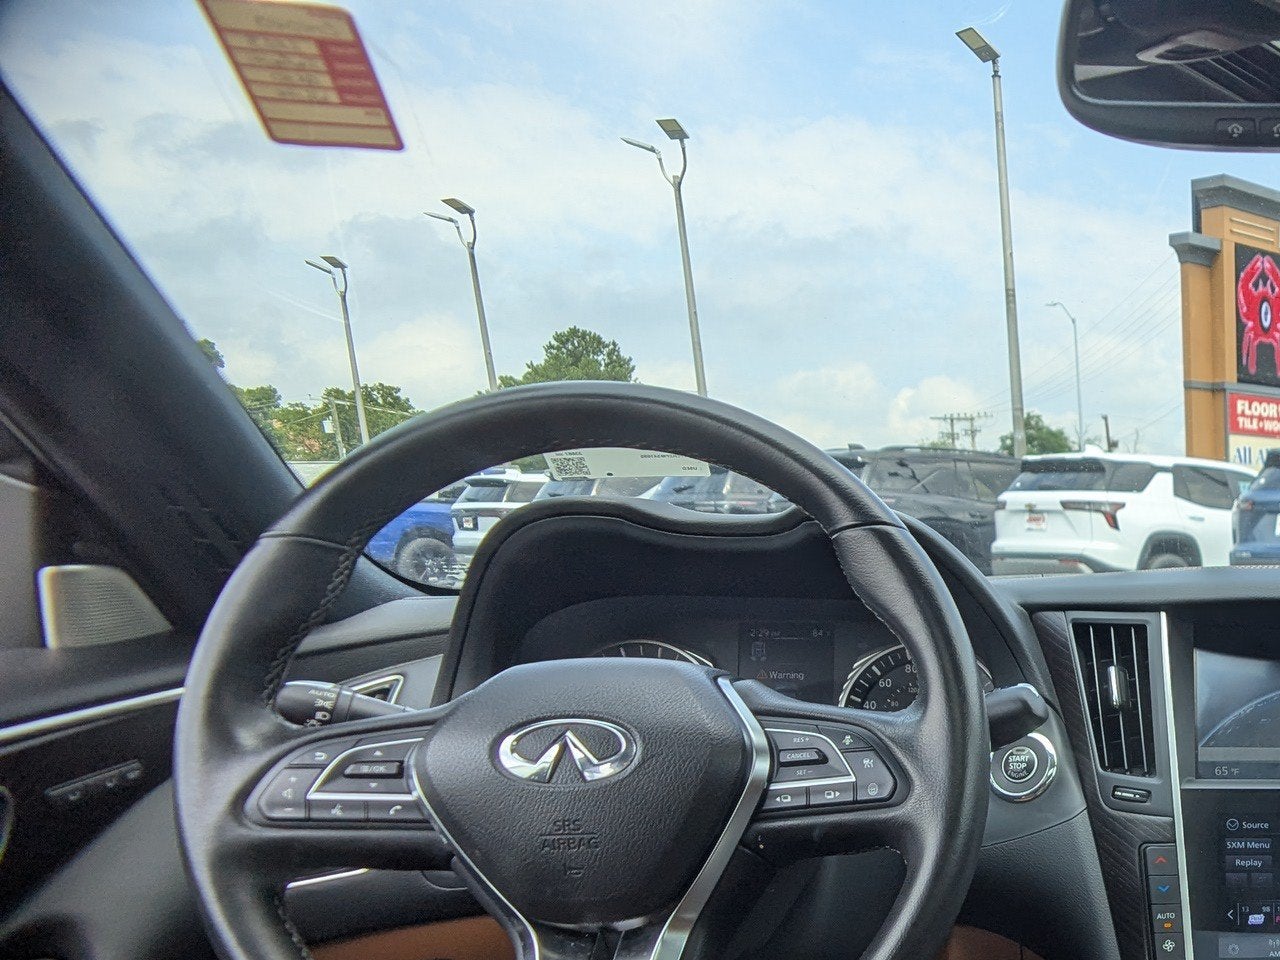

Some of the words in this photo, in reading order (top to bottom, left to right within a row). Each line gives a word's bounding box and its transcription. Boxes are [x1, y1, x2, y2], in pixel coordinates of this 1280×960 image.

[1236, 399, 1278, 418] FLOOR
[769, 670, 805, 681] Warning
[879, 678, 892, 688] 60
[308, 689, 337, 698] AUTO
[863, 700, 877, 710] 40
[1008, 755, 1029, 763] START
[1009, 762, 1027, 770] STOP
[1214, 766, 1229, 776] 65
[1242, 821, 1270, 829] Source
[1226, 841, 1245, 849] SXM
[1246, 841, 1270, 849] Menu
[1235, 859, 1263, 868] Replay
[1156, 912, 1176, 920] AUTO
